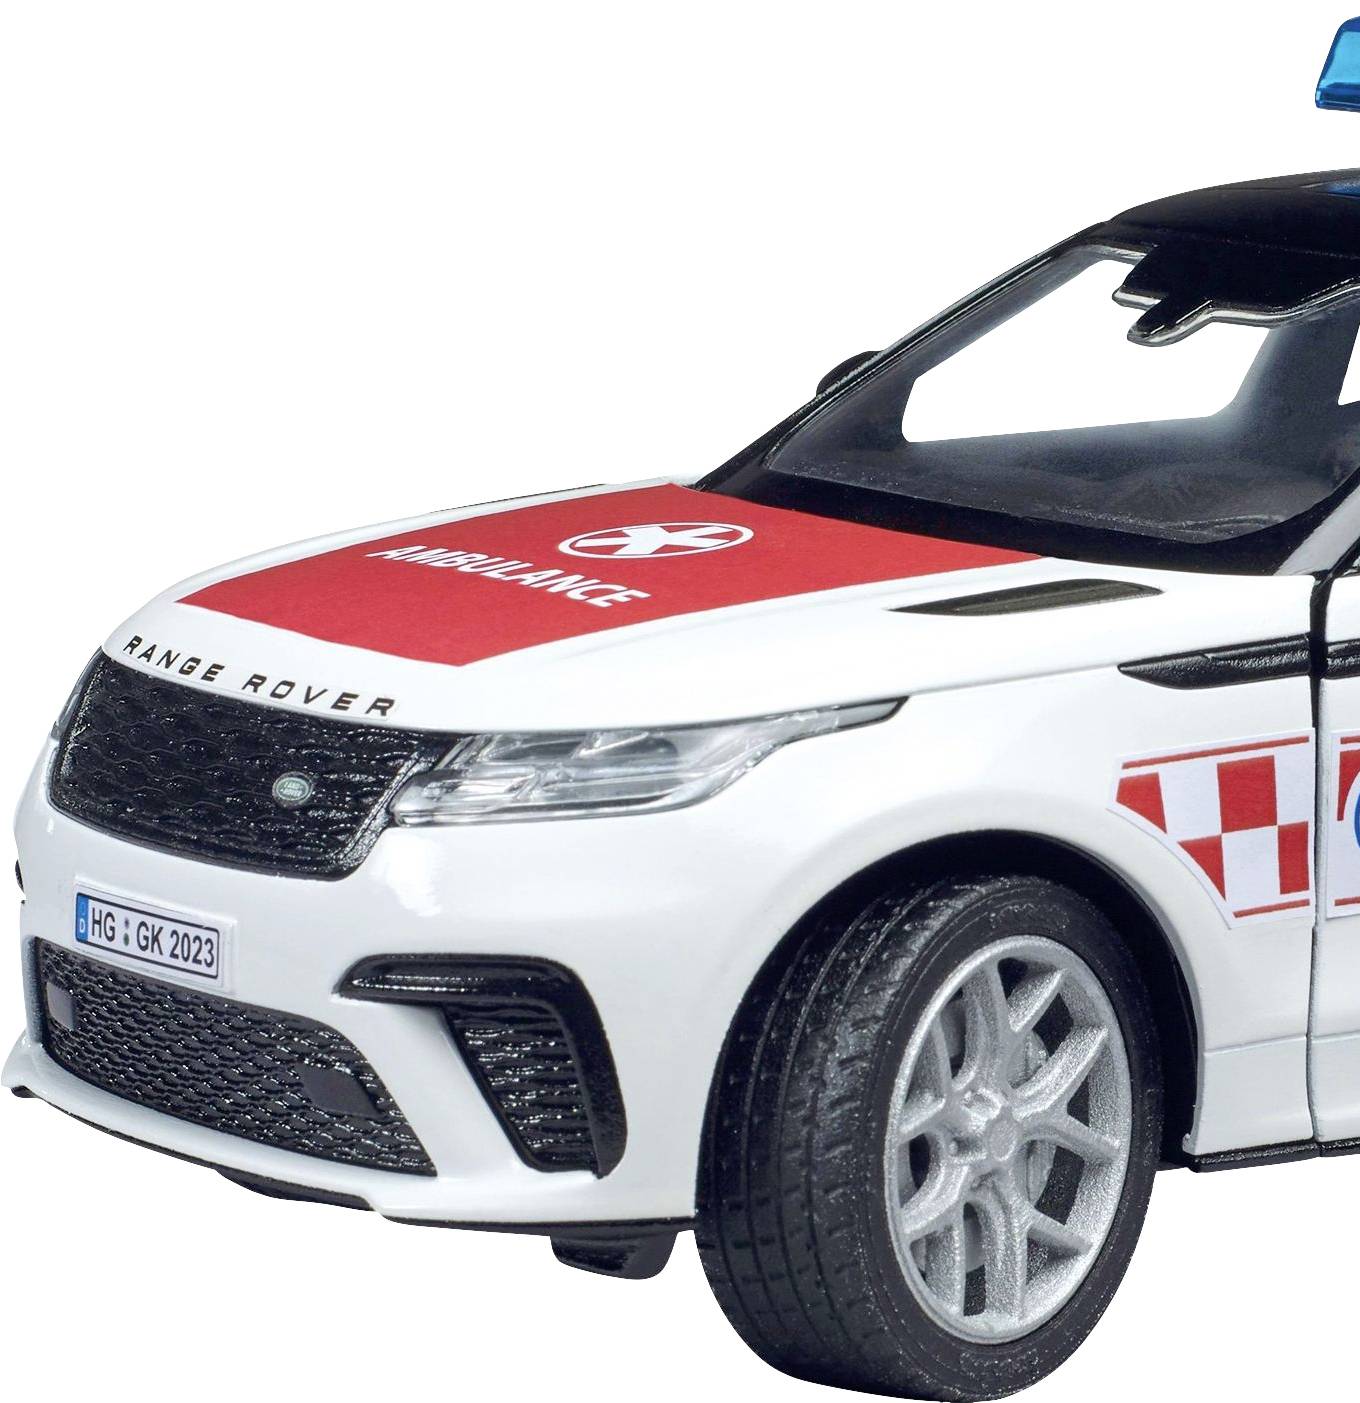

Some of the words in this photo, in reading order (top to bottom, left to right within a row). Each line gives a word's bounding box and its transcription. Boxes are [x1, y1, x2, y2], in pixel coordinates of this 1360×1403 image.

[365, 545, 651, 607] AMBULANCE
[123, 635, 225, 682] RANGE
[242, 673, 395, 716] ROVER
[79, 918, 86, 933] D
[91, 907, 116, 942] HG
[136, 921, 164, 956] GK
[169, 929, 215, 968] 2023
